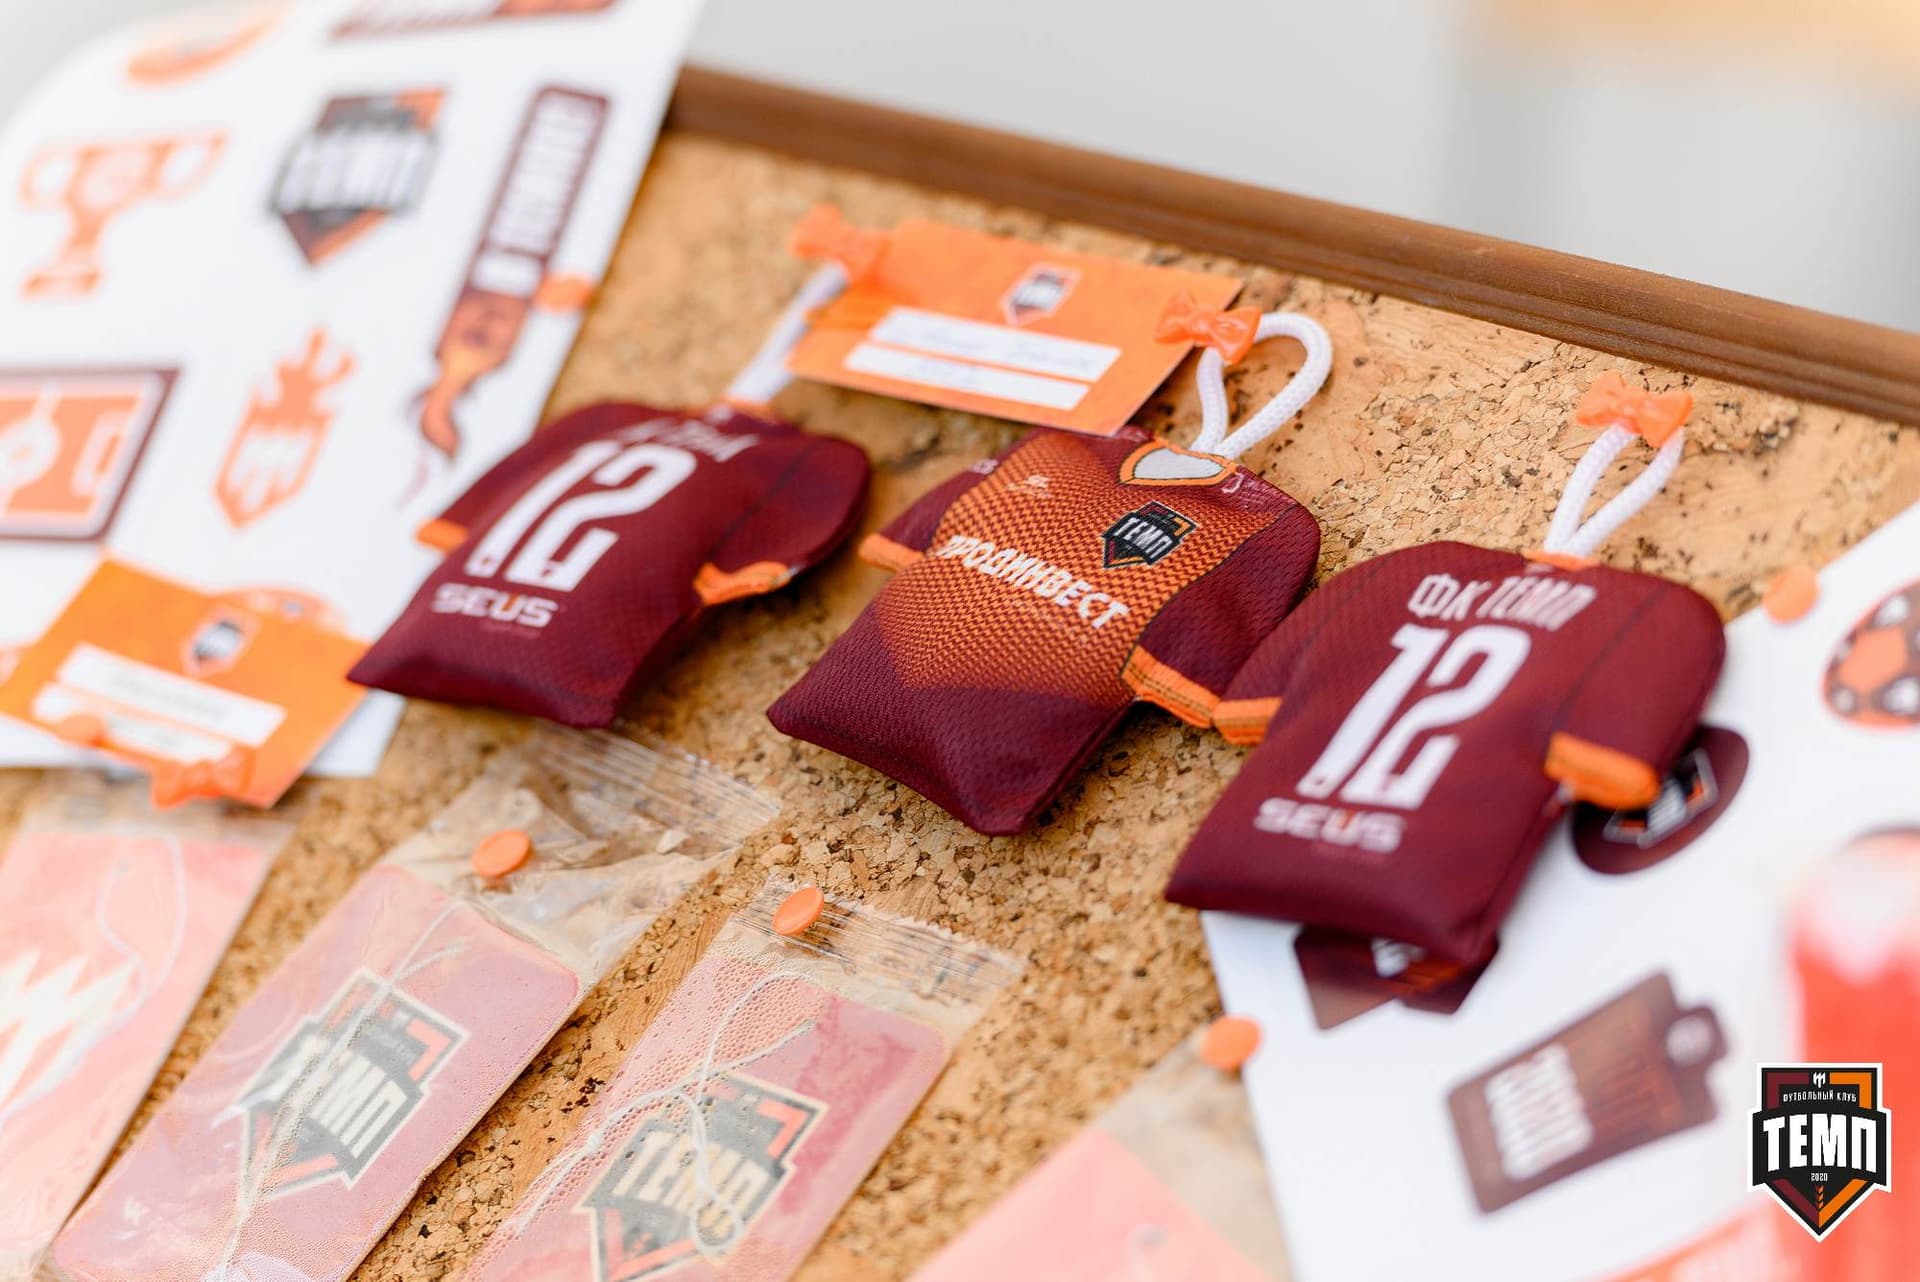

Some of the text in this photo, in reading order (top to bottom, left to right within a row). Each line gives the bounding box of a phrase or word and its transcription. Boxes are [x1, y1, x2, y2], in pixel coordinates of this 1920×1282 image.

[463, 439, 698, 592] 12
[1113, 515, 1173, 559] ТЕМП
[431, 582, 560, 629] SEUS
[1407, 573, 1491, 621] ФК
[1296, 622, 1533, 811] 12
[1253, 797, 1407, 855] SEUS
